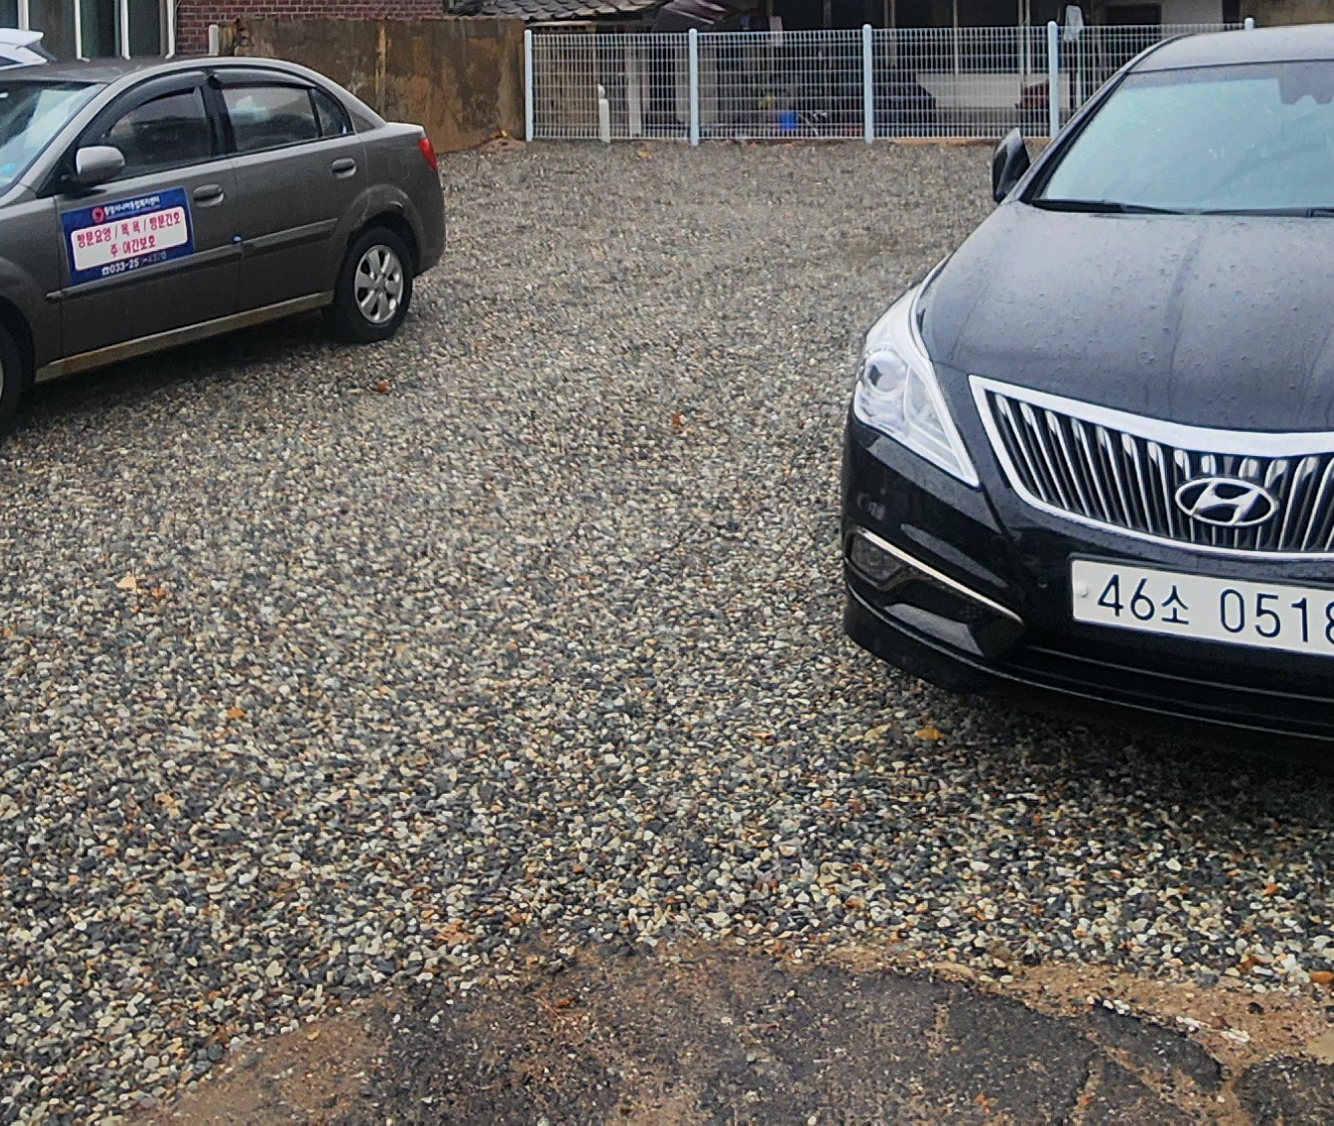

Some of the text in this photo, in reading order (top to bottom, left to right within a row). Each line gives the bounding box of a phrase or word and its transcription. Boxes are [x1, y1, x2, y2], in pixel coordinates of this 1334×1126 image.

[77, 227, 112, 249] 방문요양
[149, 211, 181, 231] 방문간호
[1097, 574, 1190, 626] 46소
